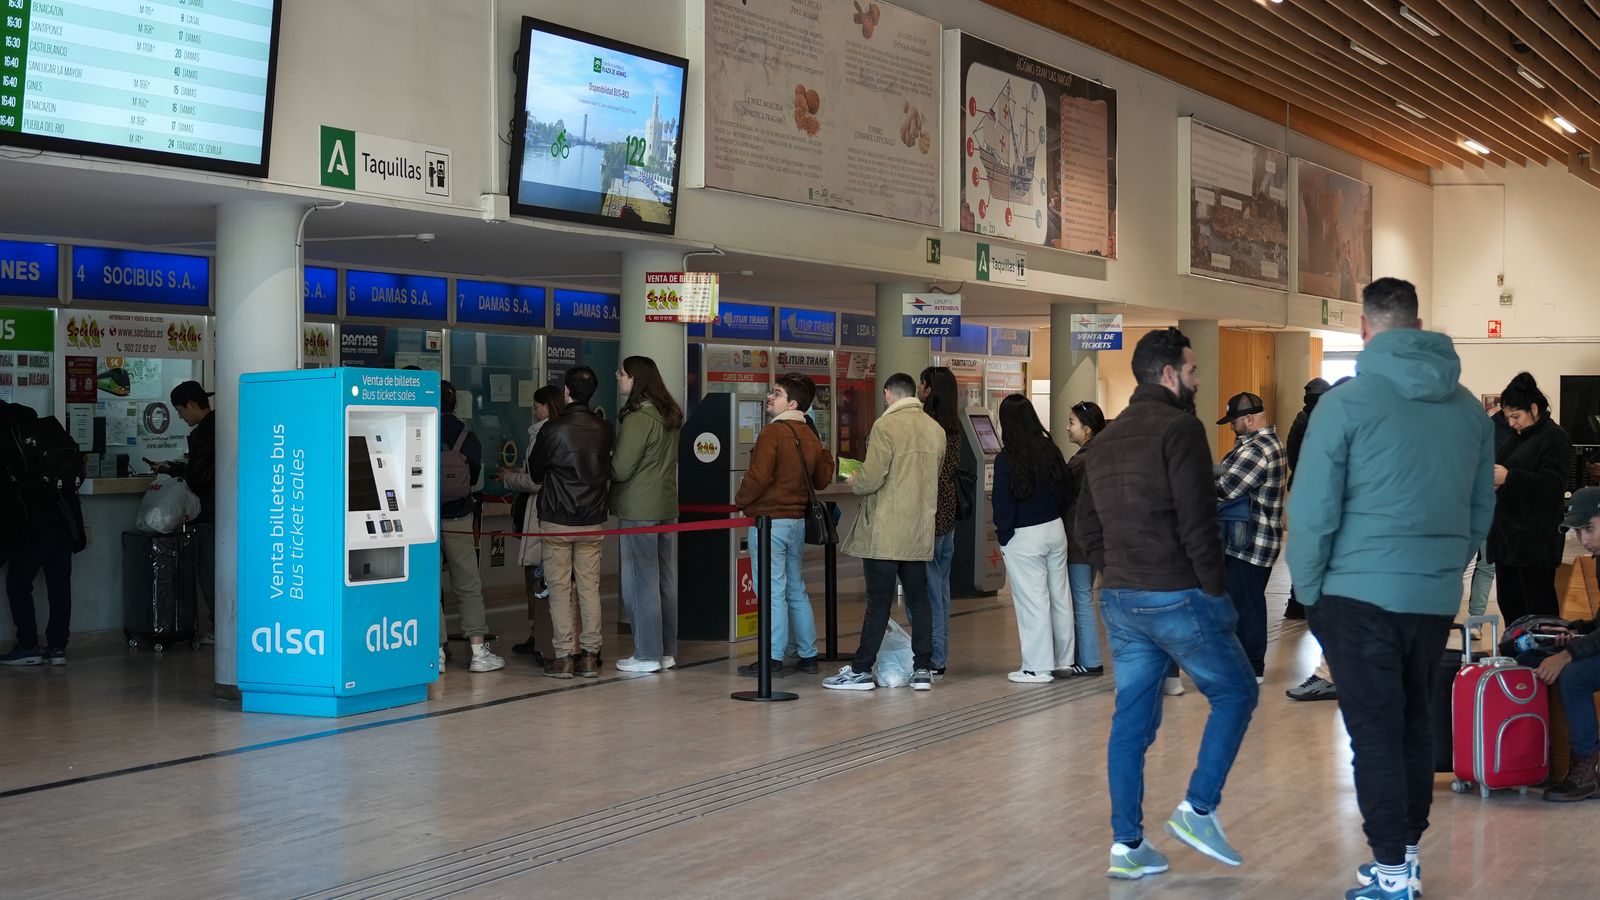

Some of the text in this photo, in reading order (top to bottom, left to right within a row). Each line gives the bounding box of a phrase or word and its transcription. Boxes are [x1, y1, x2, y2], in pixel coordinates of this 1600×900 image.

[6, 16, 22, 29] 16:30
[174, 48, 182, 59] 20
[4, 56, 19, 68] 16:40
[5, 36, 21, 48] 16:30
[173, 67, 181, 77] 40
[2, 75, 18, 88] 16:40
[26, 80, 43, 93] GINES
[1, 95, 16, 108] 16:40
[0, 114, 15, 127] 16:40
[625, 134, 647, 168] 122
[327, 139, 422, 181] A Taquillas
[978, 250, 1015, 275] A Taquillas
[76, 264, 196, 290] 4 SOCIBUS S.A.
[647, 274, 710, 284] VENTA DE BILLETES
[349, 286, 432, 307] 6 DAMAS S.A.
[459, 294, 532, 315] 7 DAMAS S.A.
[646, 289, 683, 303] Socibus
[555, 303, 561, 317] 8
[573, 302, 601, 319] DAMAS
[66, 319, 105, 339] Socibus
[748, 315, 769, 326] TRANS
[812, 320, 834, 334] TRANS
[911, 317, 954, 325] VENTA DE
[118, 327, 164, 339] www.socibus.es
[167, 322, 202, 343] Socibus
[915, 327, 950, 335] TICKETS
[304, 334, 330, 349] ocibus
[341, 334, 378, 347] DAMAS
[1081, 341, 1112, 349] TICKETS
[547, 346, 576, 359] DAMAS
[777, 351, 806, 368] ELITUR
[806, 356, 829, 366] TRANS
[362, 374, 421, 388] Venta de billetes
[362, 388, 417, 402] Bus ticket sales
[270, 424, 285, 599] Venta billetes bus
[289, 449, 304, 600] Bus ticket sales
[251, 621, 325, 656] alsa
[365, 616, 418, 652] alsa
